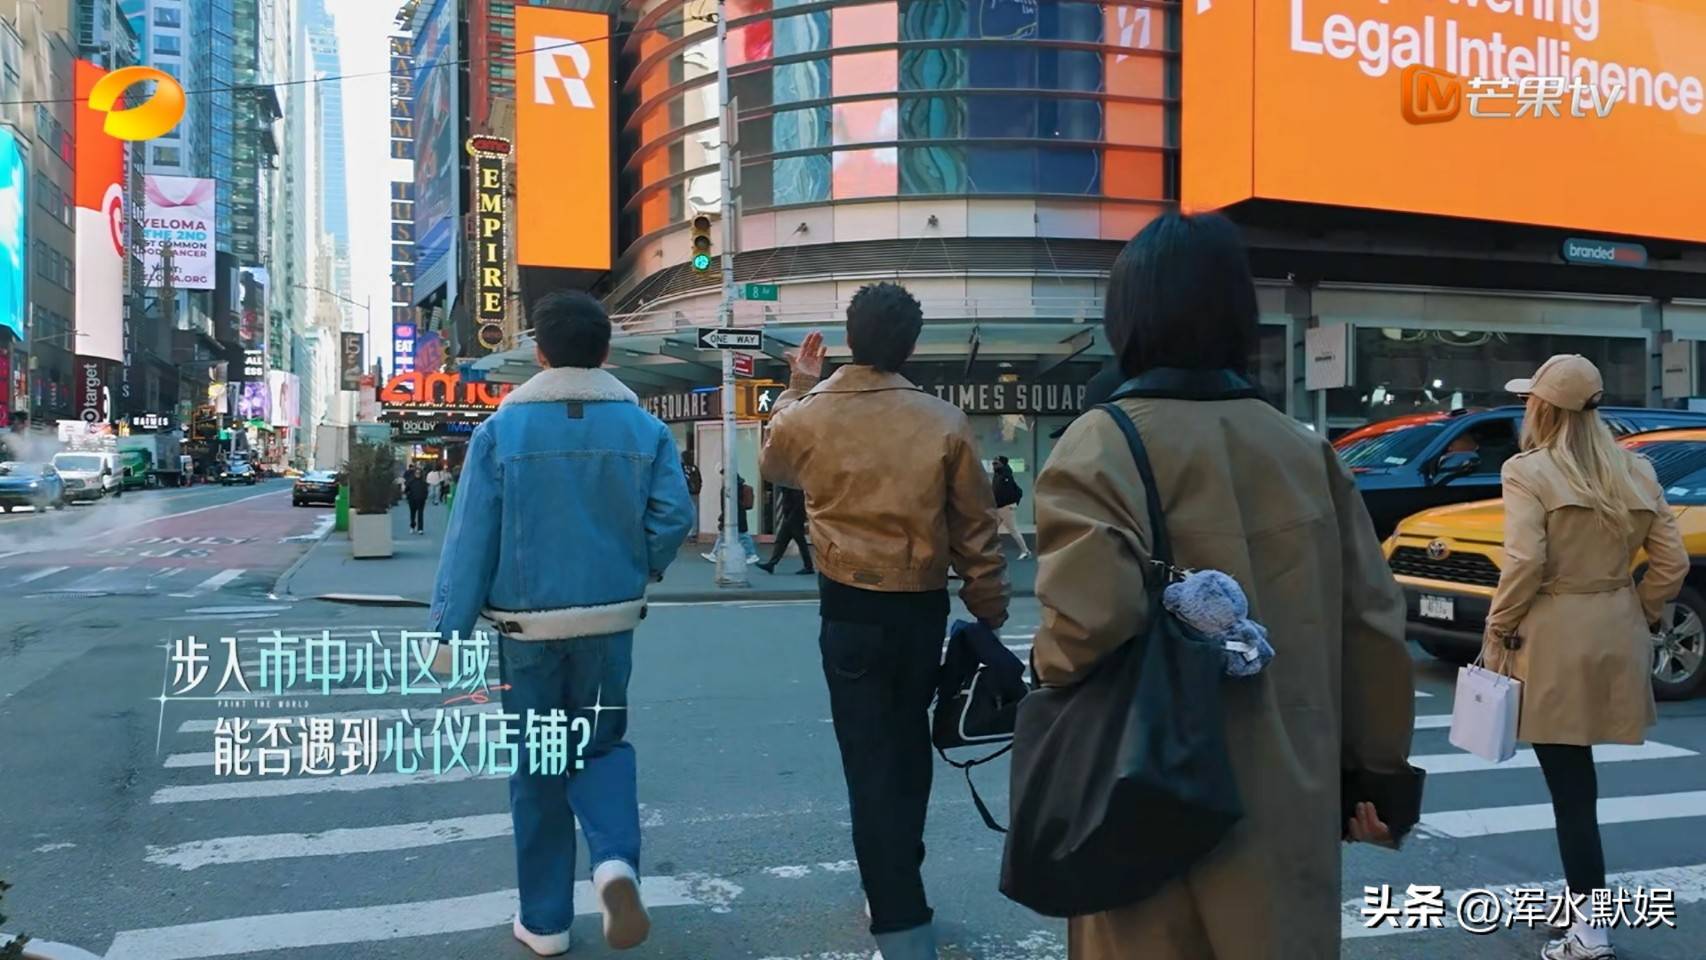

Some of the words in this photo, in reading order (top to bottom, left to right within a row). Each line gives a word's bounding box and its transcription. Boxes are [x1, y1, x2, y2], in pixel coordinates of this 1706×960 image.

[1290, 0, 1434, 77] Legal
[1446, 20, 1705, 116] Intelligence
[143, 219, 207, 231] YELOMA
[177, 231, 207, 241] 2ND
[480, 168, 502, 312] EMPIRE
[173, 249, 208, 258] ANCER
[1569, 243, 1616, 260] branded
[752, 287, 759, 298] 8
[710, 334, 728, 344] ONE
[736, 335, 755, 344] WAY
[83, 363, 101, 407] target
[935, 384, 1005, 410] TIMES
[1016, 384, 1087, 411] SQUAR
[661, 392, 707, 419] SQUARE
[403, 421, 435, 431] DOLBY
[448, 424, 472, 433] IMA
